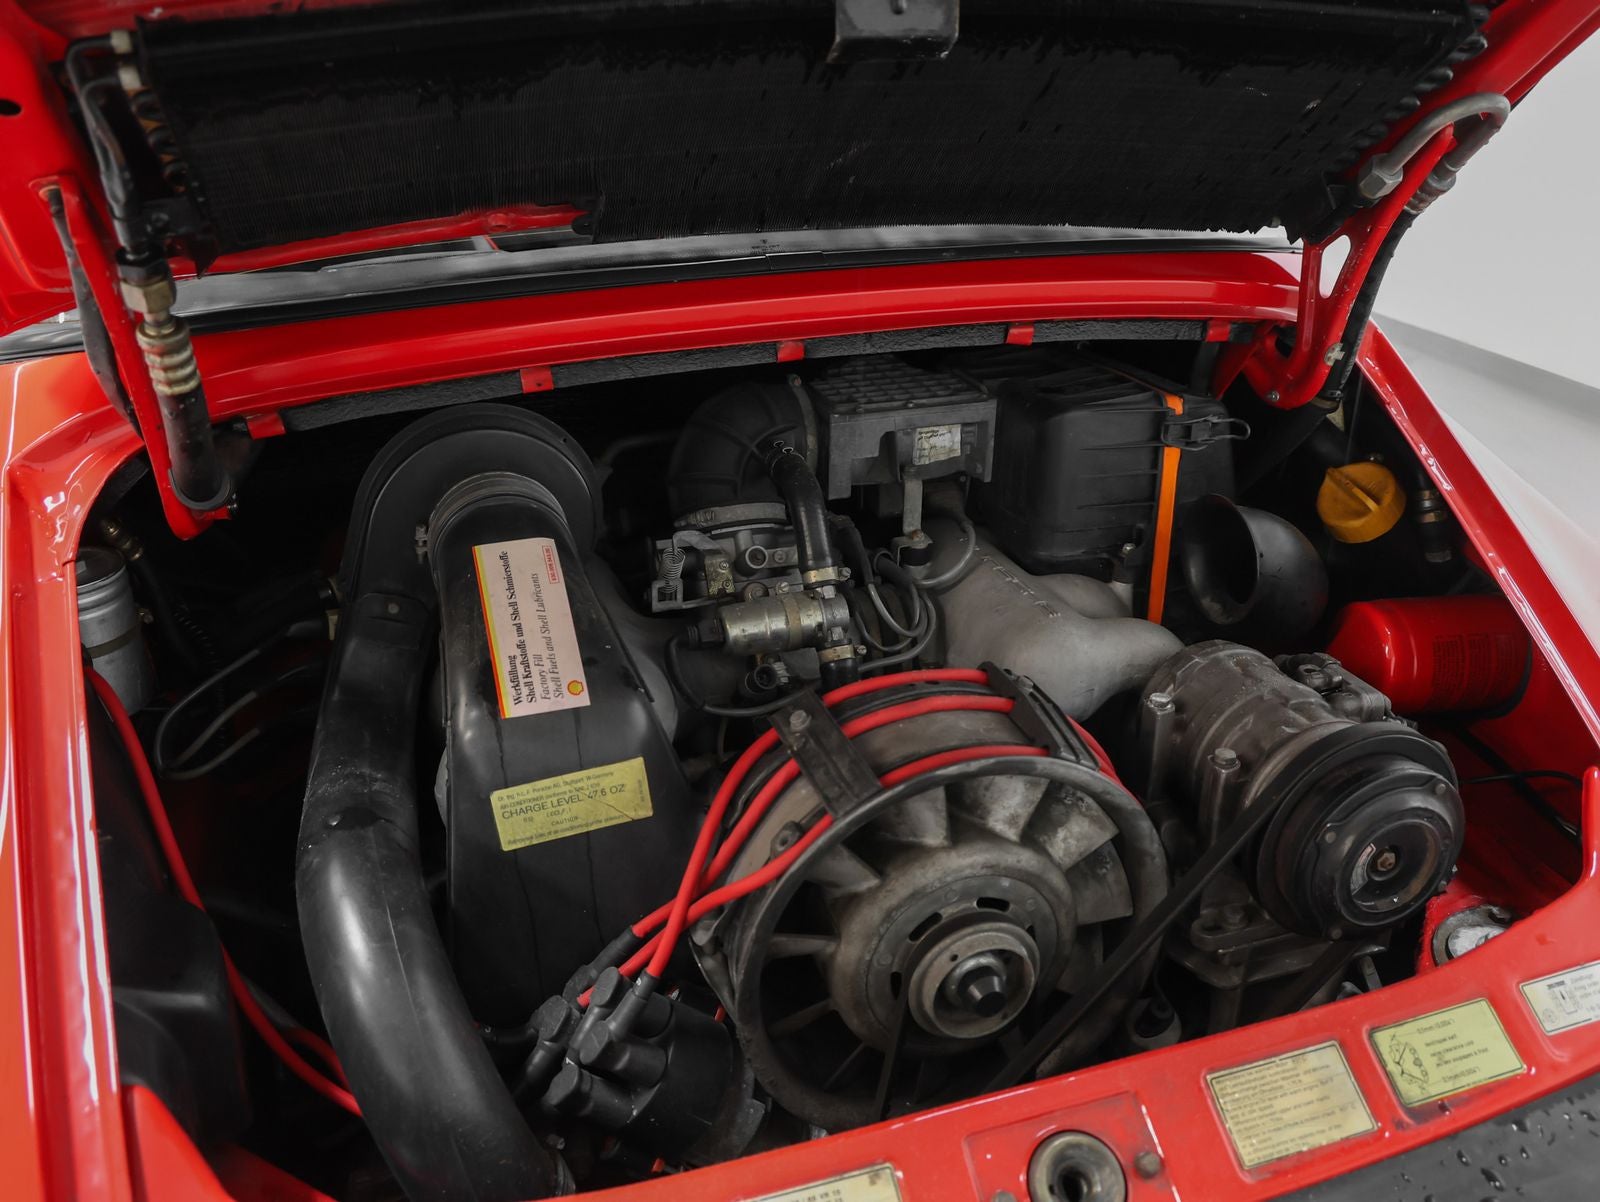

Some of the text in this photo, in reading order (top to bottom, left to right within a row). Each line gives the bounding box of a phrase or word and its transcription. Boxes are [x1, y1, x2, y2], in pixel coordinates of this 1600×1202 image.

[499, 551, 537, 703] Shell Kraftstoffe und Shell Schmierstoffe
[531, 573, 564, 699] Shell Fuels and Shell Lubricants
[508, 654, 523, 705] Werkfüllung
[532, 654, 551, 700] Factory Fill
[502, 802, 549, 820] CHARGE
[551, 795, 583, 809] LEVEL
[588, 787, 607, 800] 47.6
[609, 783, 625, 795] OZ
